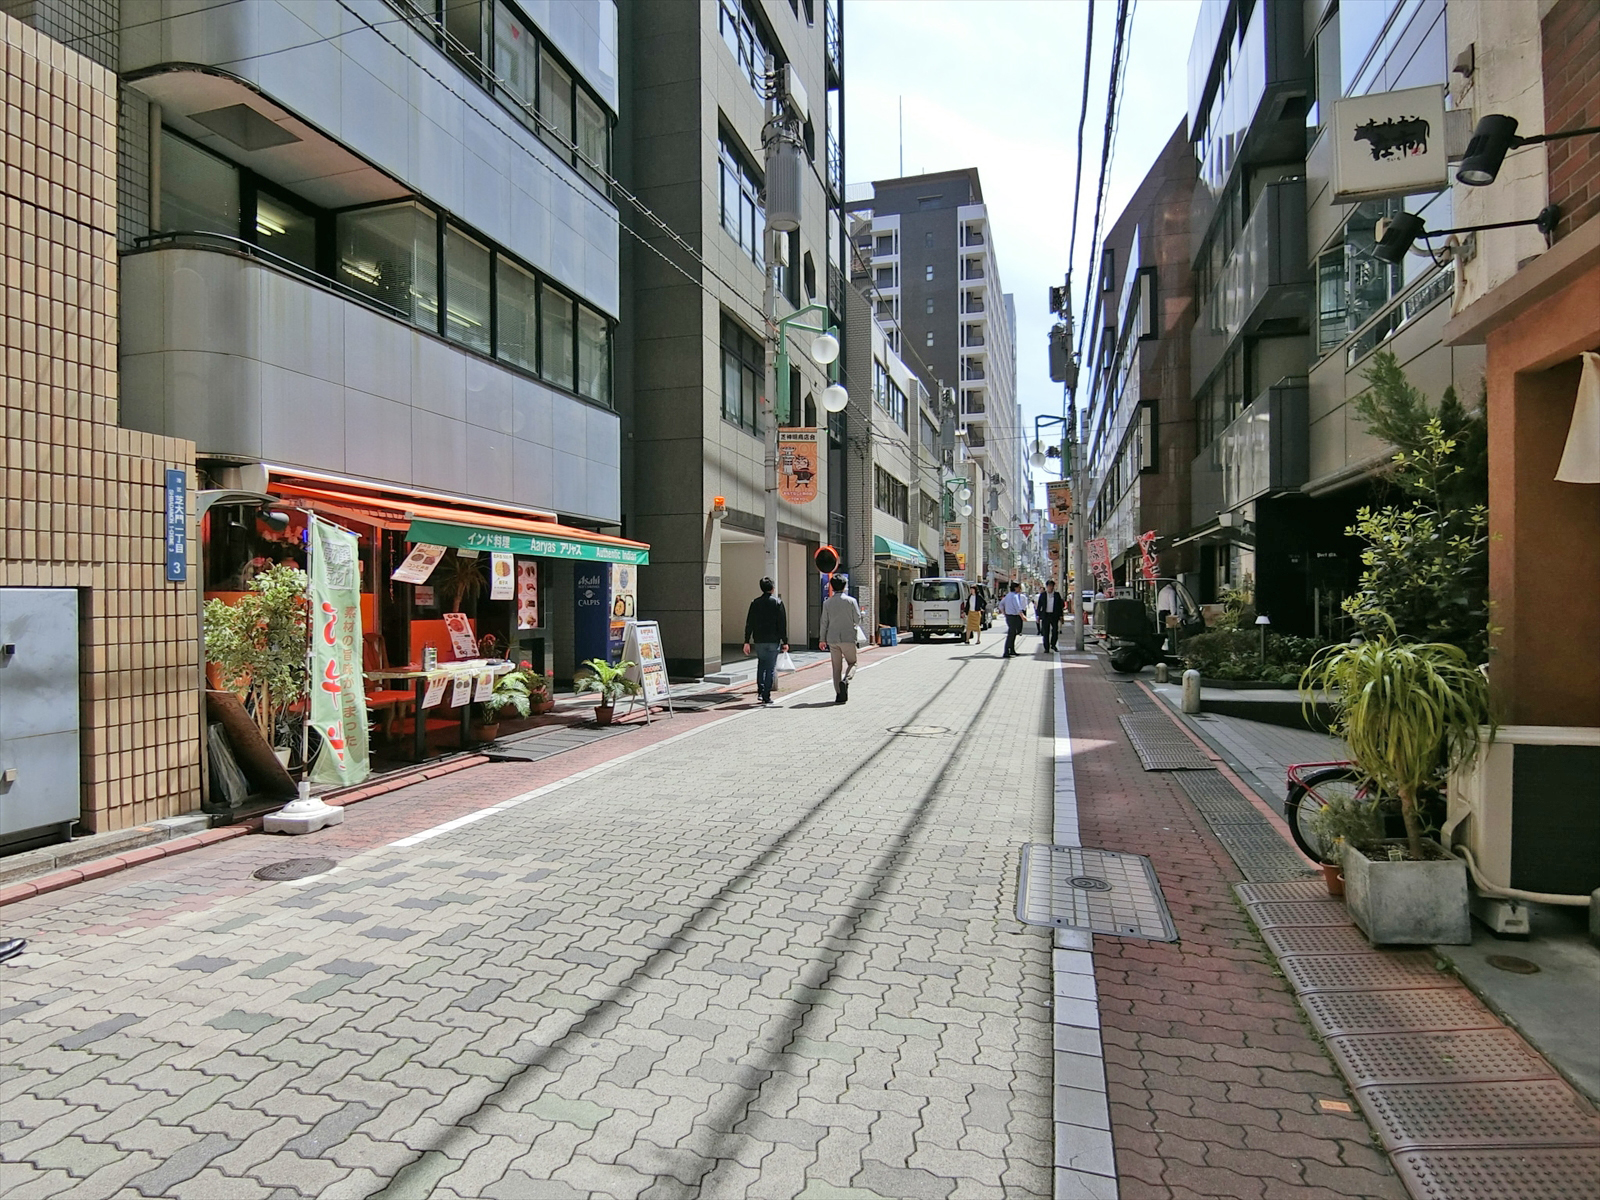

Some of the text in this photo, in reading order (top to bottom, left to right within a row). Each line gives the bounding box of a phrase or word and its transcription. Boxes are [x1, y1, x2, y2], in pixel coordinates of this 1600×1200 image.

[174, 495, 184, 554] 芝大門一丁目
[467, 532, 511, 549] インド料理
[530, 537, 583, 556] Aaryas アリャス
[595, 546, 637, 561] Authentic Indian
[173, 562, 181, 574] 3
[577, 575, 601, 586] Asahi
[577, 599, 601, 607] CALPIS
[342, 606, 359, 748] 素材の旨味がつまった
